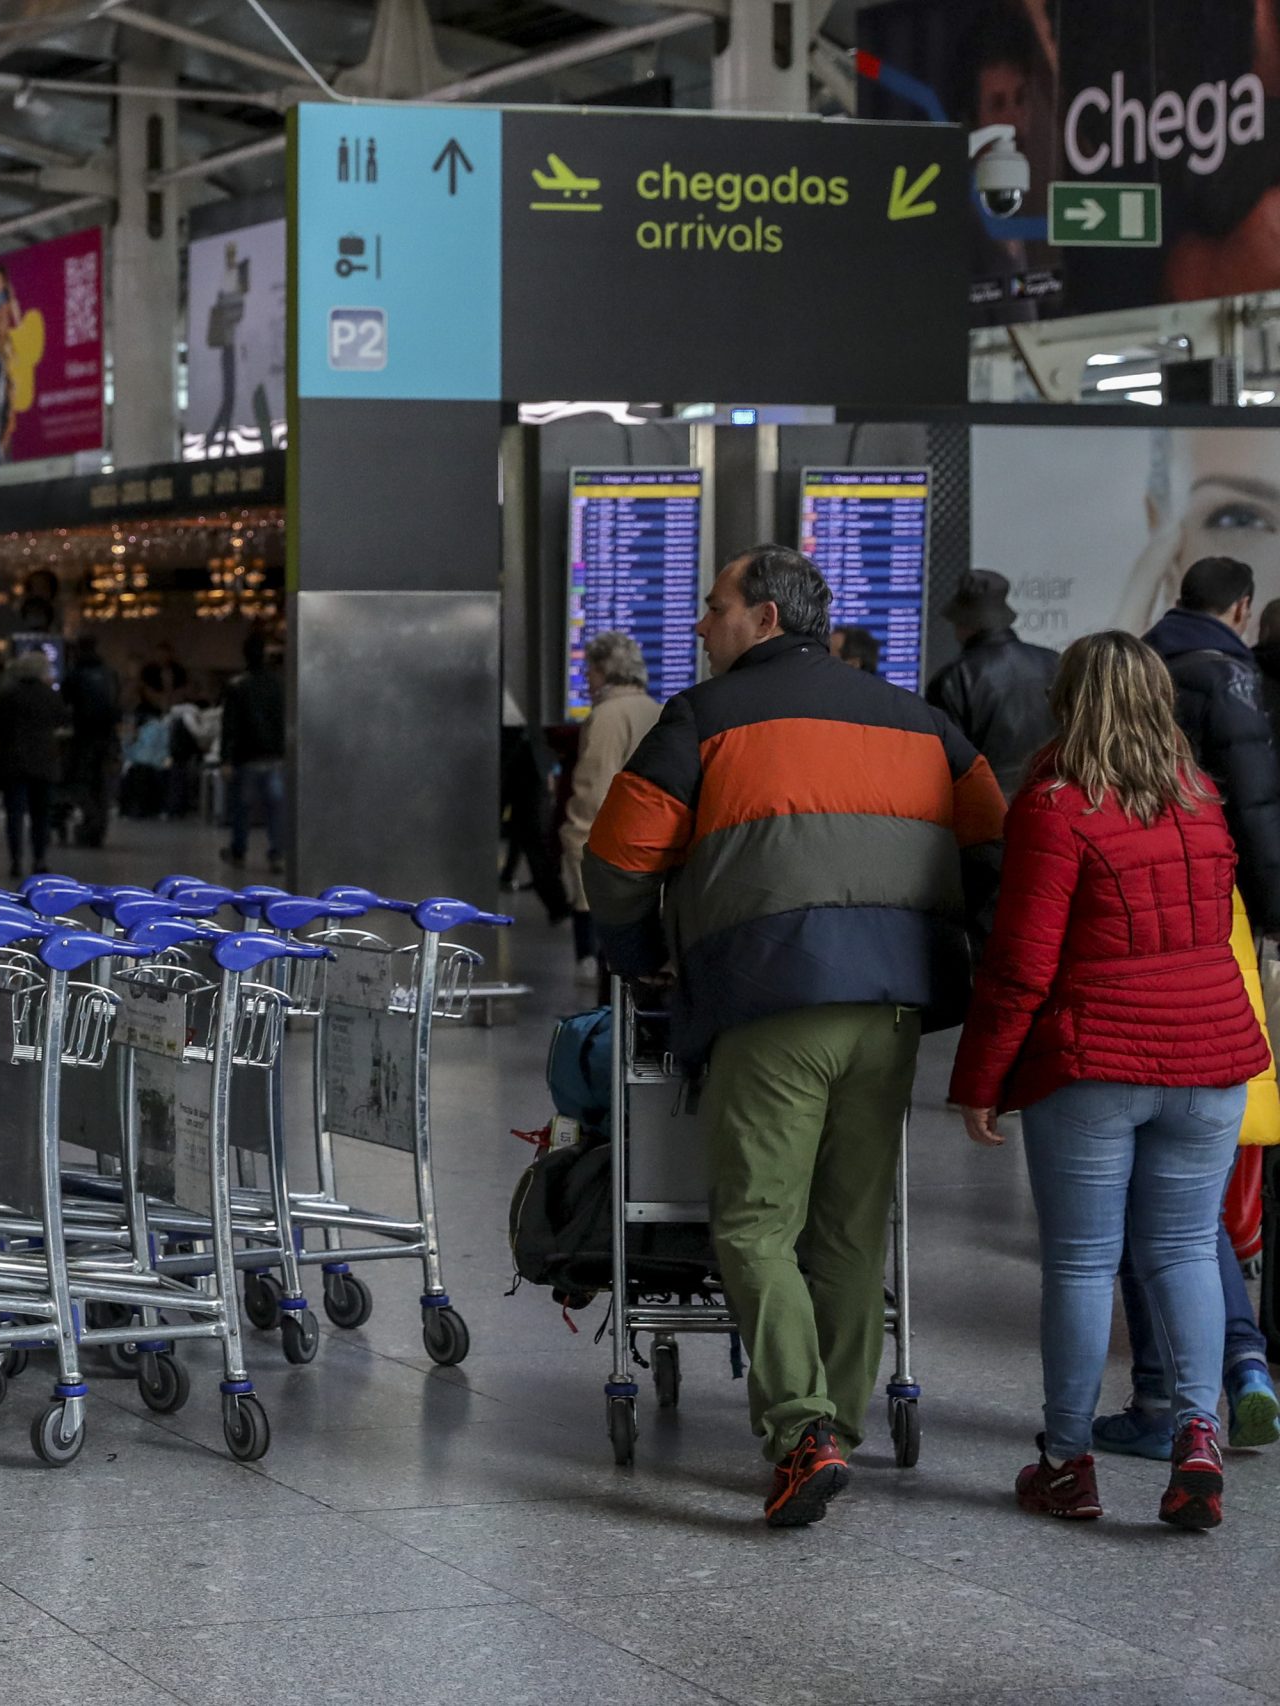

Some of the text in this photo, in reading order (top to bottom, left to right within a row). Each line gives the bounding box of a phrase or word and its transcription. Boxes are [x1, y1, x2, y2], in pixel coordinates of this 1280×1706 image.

[1064, 71, 1264, 175] Chega
[636, 163, 849, 211] chegadas
[636, 217, 782, 253] arrivals
[331, 321, 384, 359] P2
